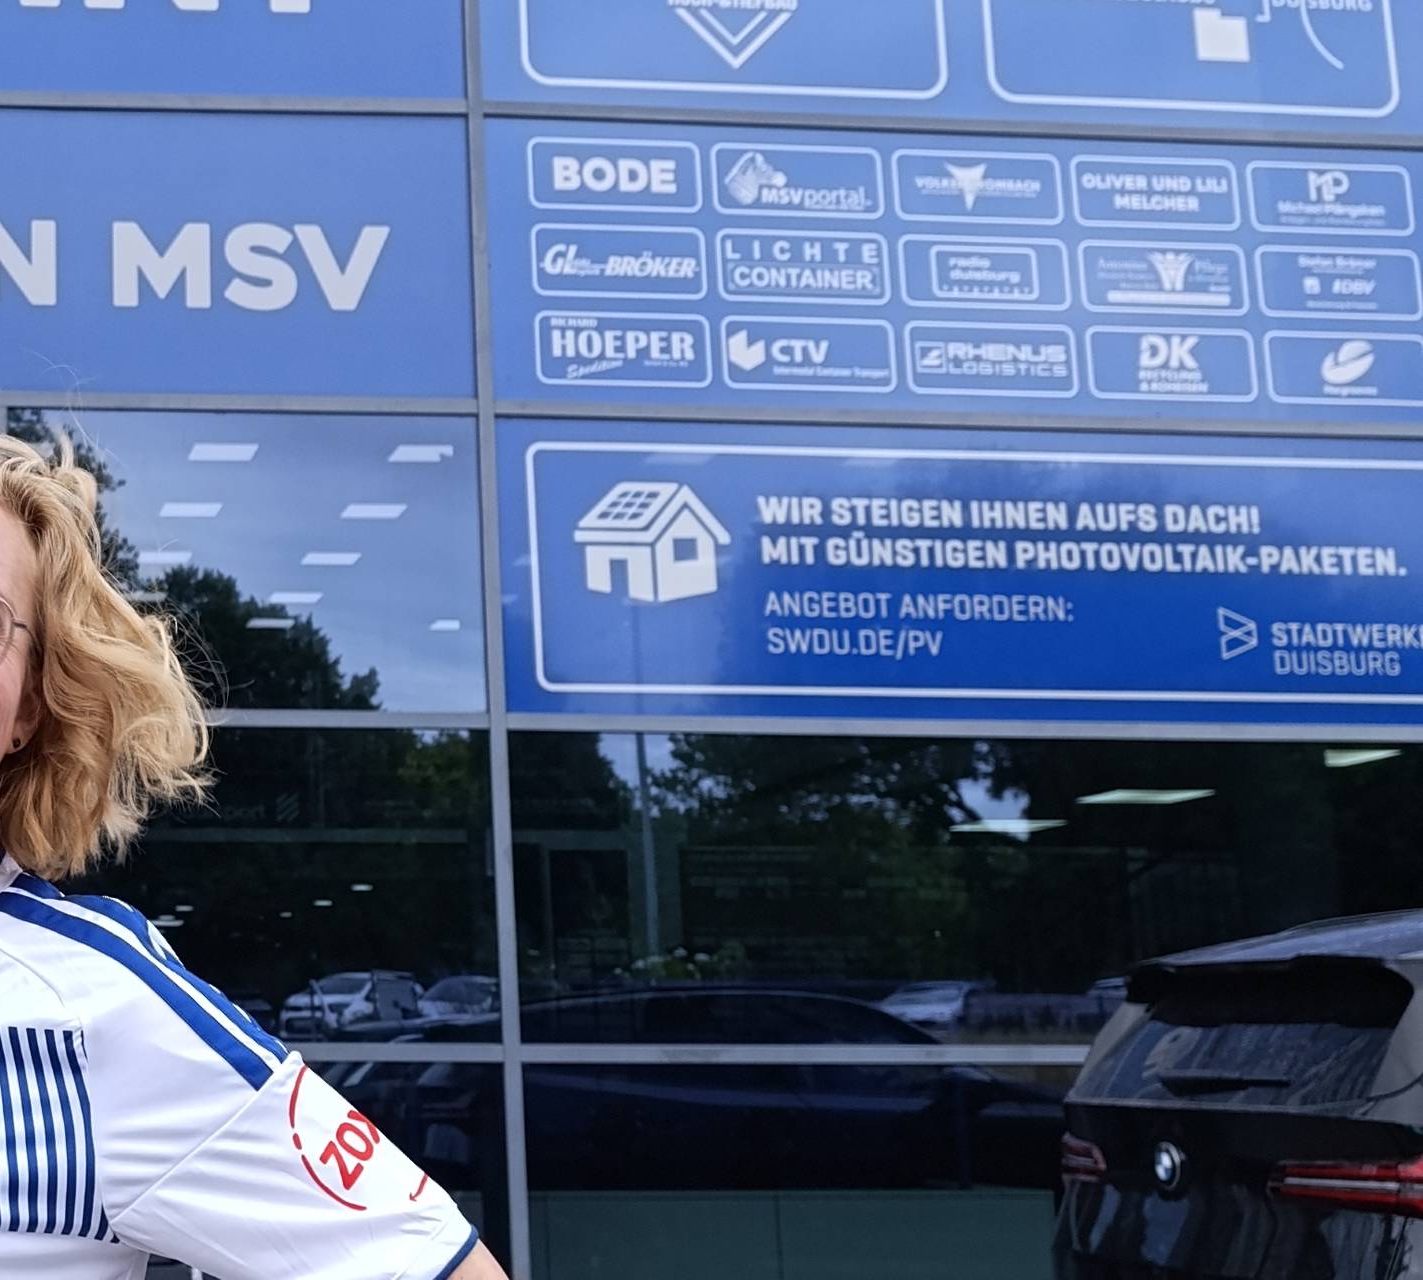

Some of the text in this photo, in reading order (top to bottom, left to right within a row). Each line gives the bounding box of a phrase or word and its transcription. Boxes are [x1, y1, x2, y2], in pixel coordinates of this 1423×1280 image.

[553, 156, 677, 194] BODE
[1081, 172, 1229, 193] OLIVER UND LILI
[1113, 193, 1201, 212] MELCHER
[112, 220, 391, 312] MSV
[604, 250, 698, 279] BRÖKER
[725, 239, 880, 265] LICHTE
[733, 265, 874, 290] CONTAINER
[551, 328, 696, 361] HOEPER
[771, 338, 830, 364] CTV
[947, 342, 1067, 362] RHENUS
[1139, 334, 1201, 369] DK
[948, 361, 1068, 377] LOGISTICS
[758, 495, 1261, 534] WIR STEIGEN IHNEN AUFS DACH!
[761, 529, 1408, 576] MIT GÜNSTIGEN PHOTOVOLTAIK-PAKETEN.
[764, 590, 1076, 622] ANGEBOT ANFORDERN:
[767, 627, 945, 660] SWDU.DE/PV
[1273, 649, 1403, 676] DUISBURG
